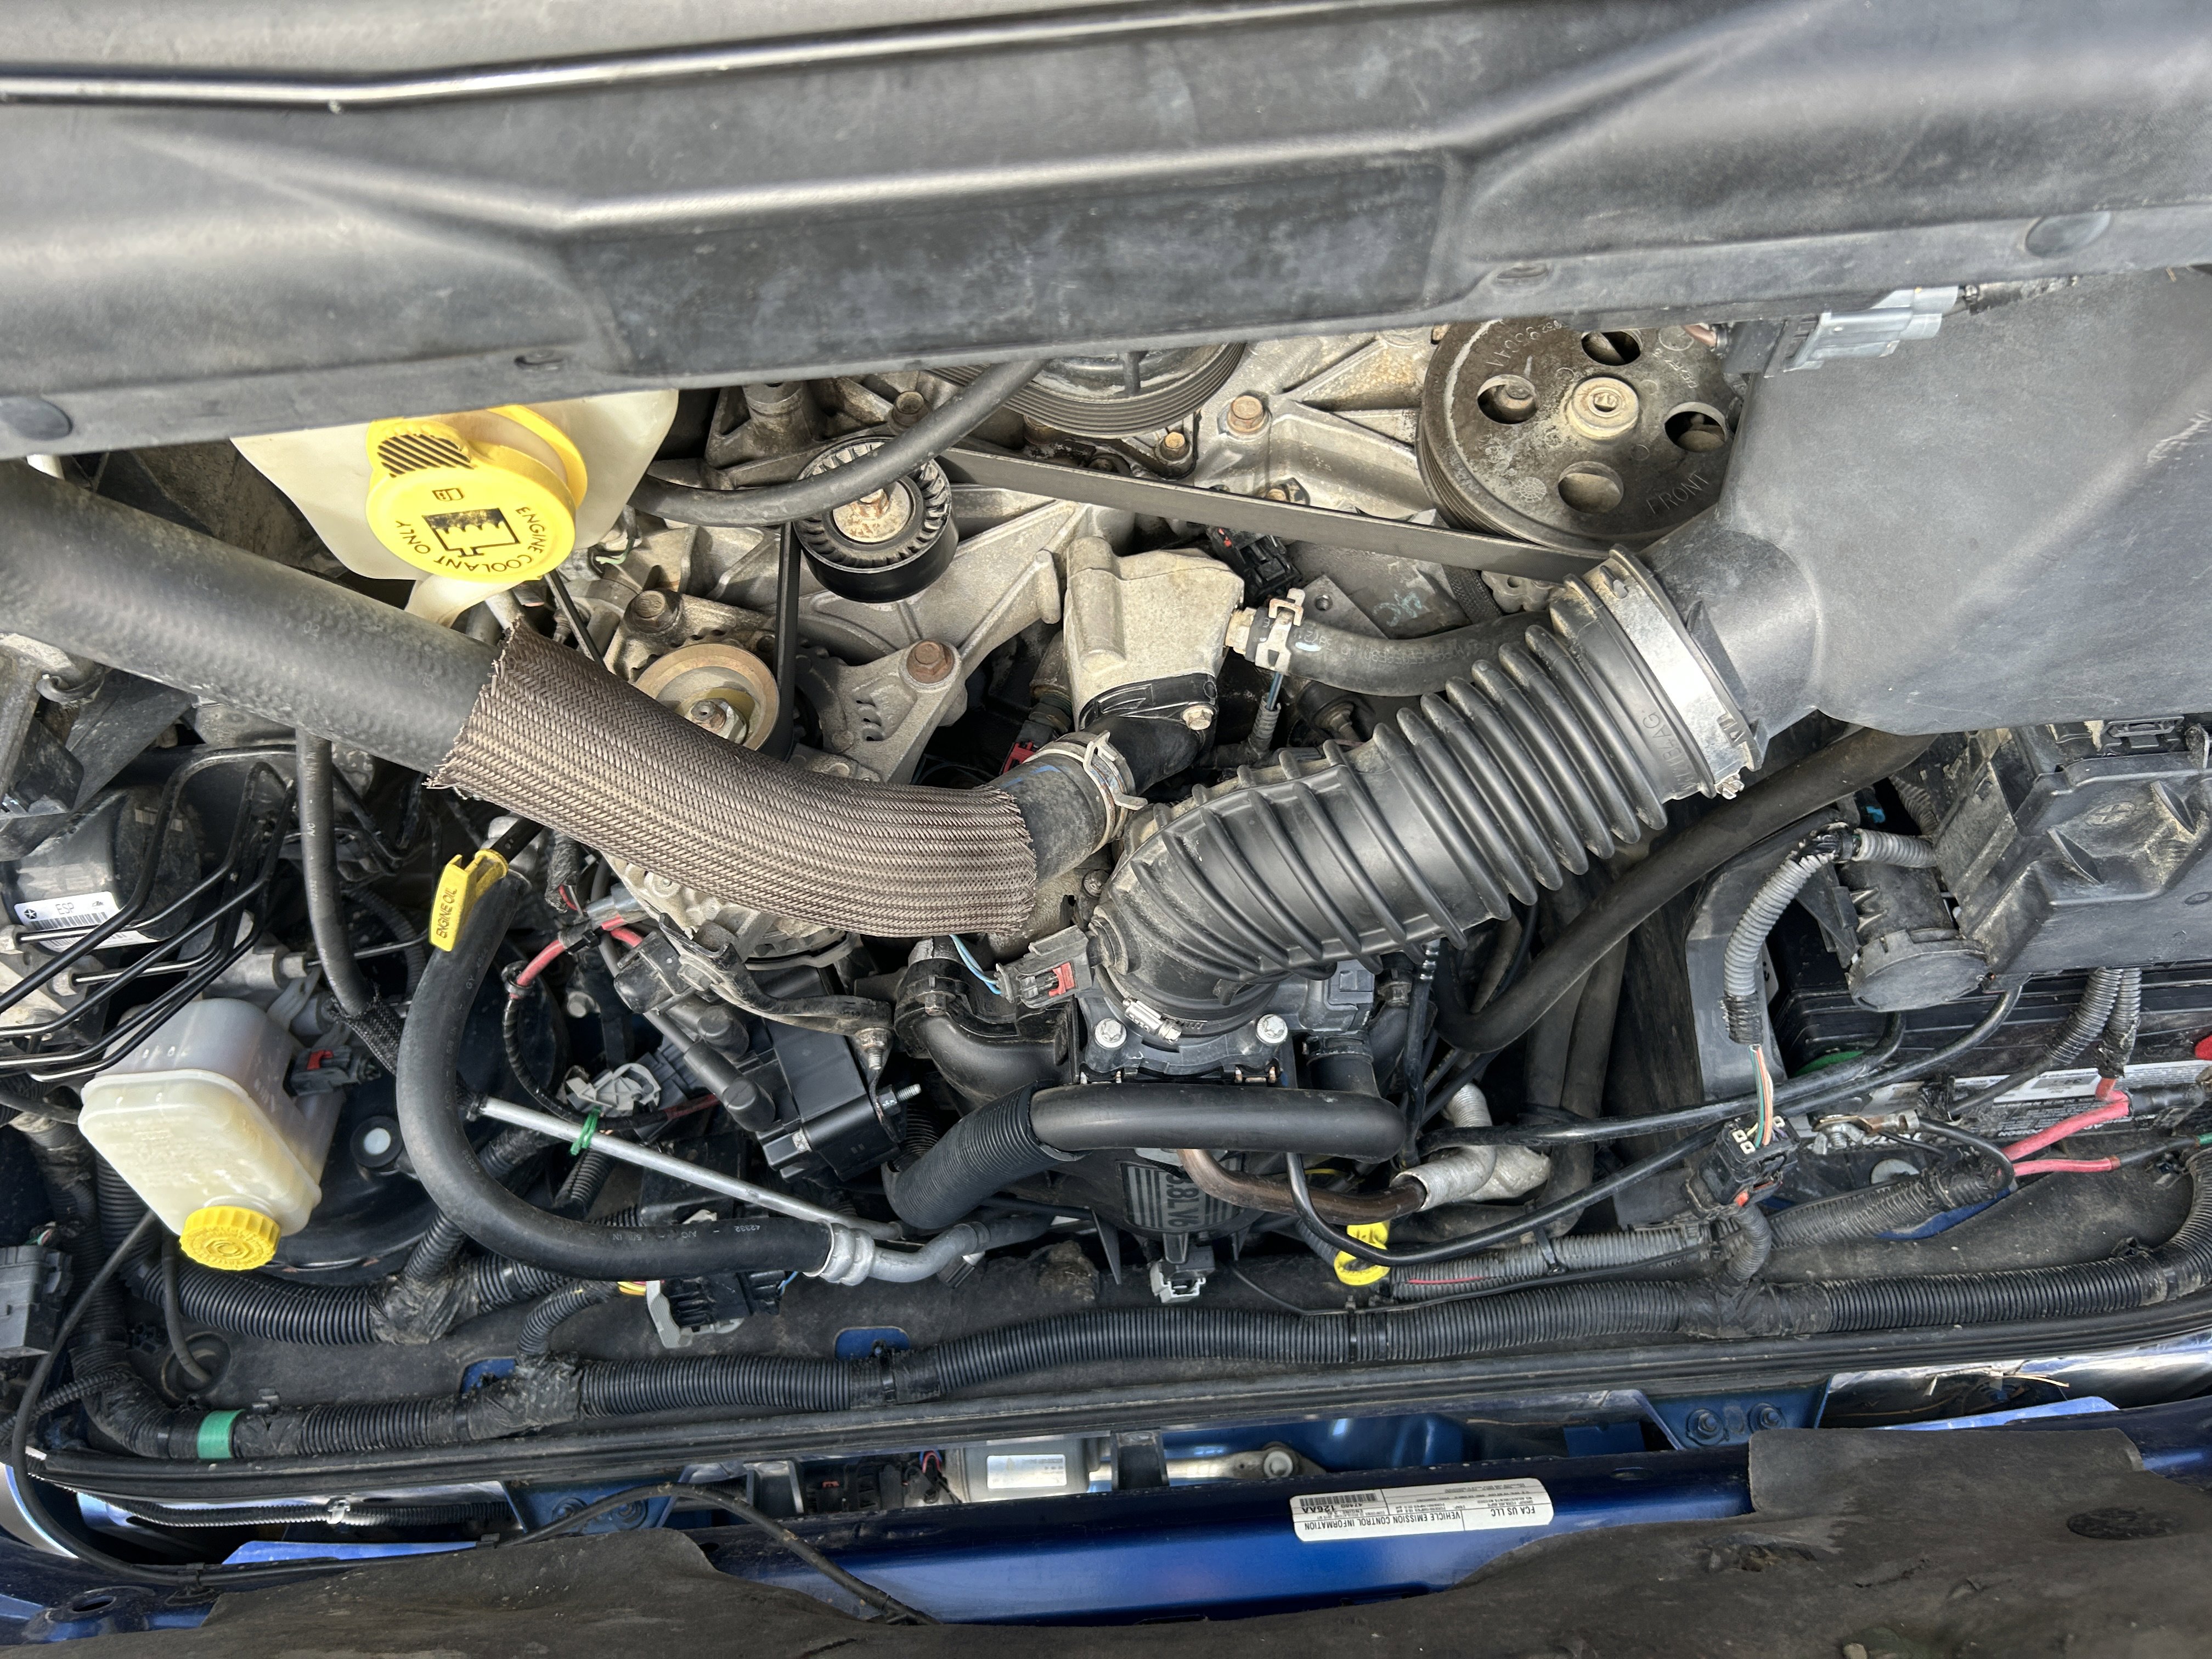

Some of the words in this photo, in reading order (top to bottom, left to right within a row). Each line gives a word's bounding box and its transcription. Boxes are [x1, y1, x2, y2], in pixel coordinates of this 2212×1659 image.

[515, 506, 546, 554] ENGINE
[395, 520, 431, 554] ONLY
[433, 554, 533, 573] COOLANT
[442, 888, 458, 904] OIL
[55, 902, 75, 915] ESP
[436, 902, 453, 939] ENGINE
[1167, 1208, 1199, 1227] V6
[1430, 1511, 1460, 1521] VEHICLE
[1506, 1507, 1517, 1515] US
[1520, 1505, 1535, 1515] FCA
[1304, 1519, 1355, 1530] INFORMATION
[1357, 1516, 1390, 1526] CONTROL
[1392, 1514, 1427, 1523] EMISSION
